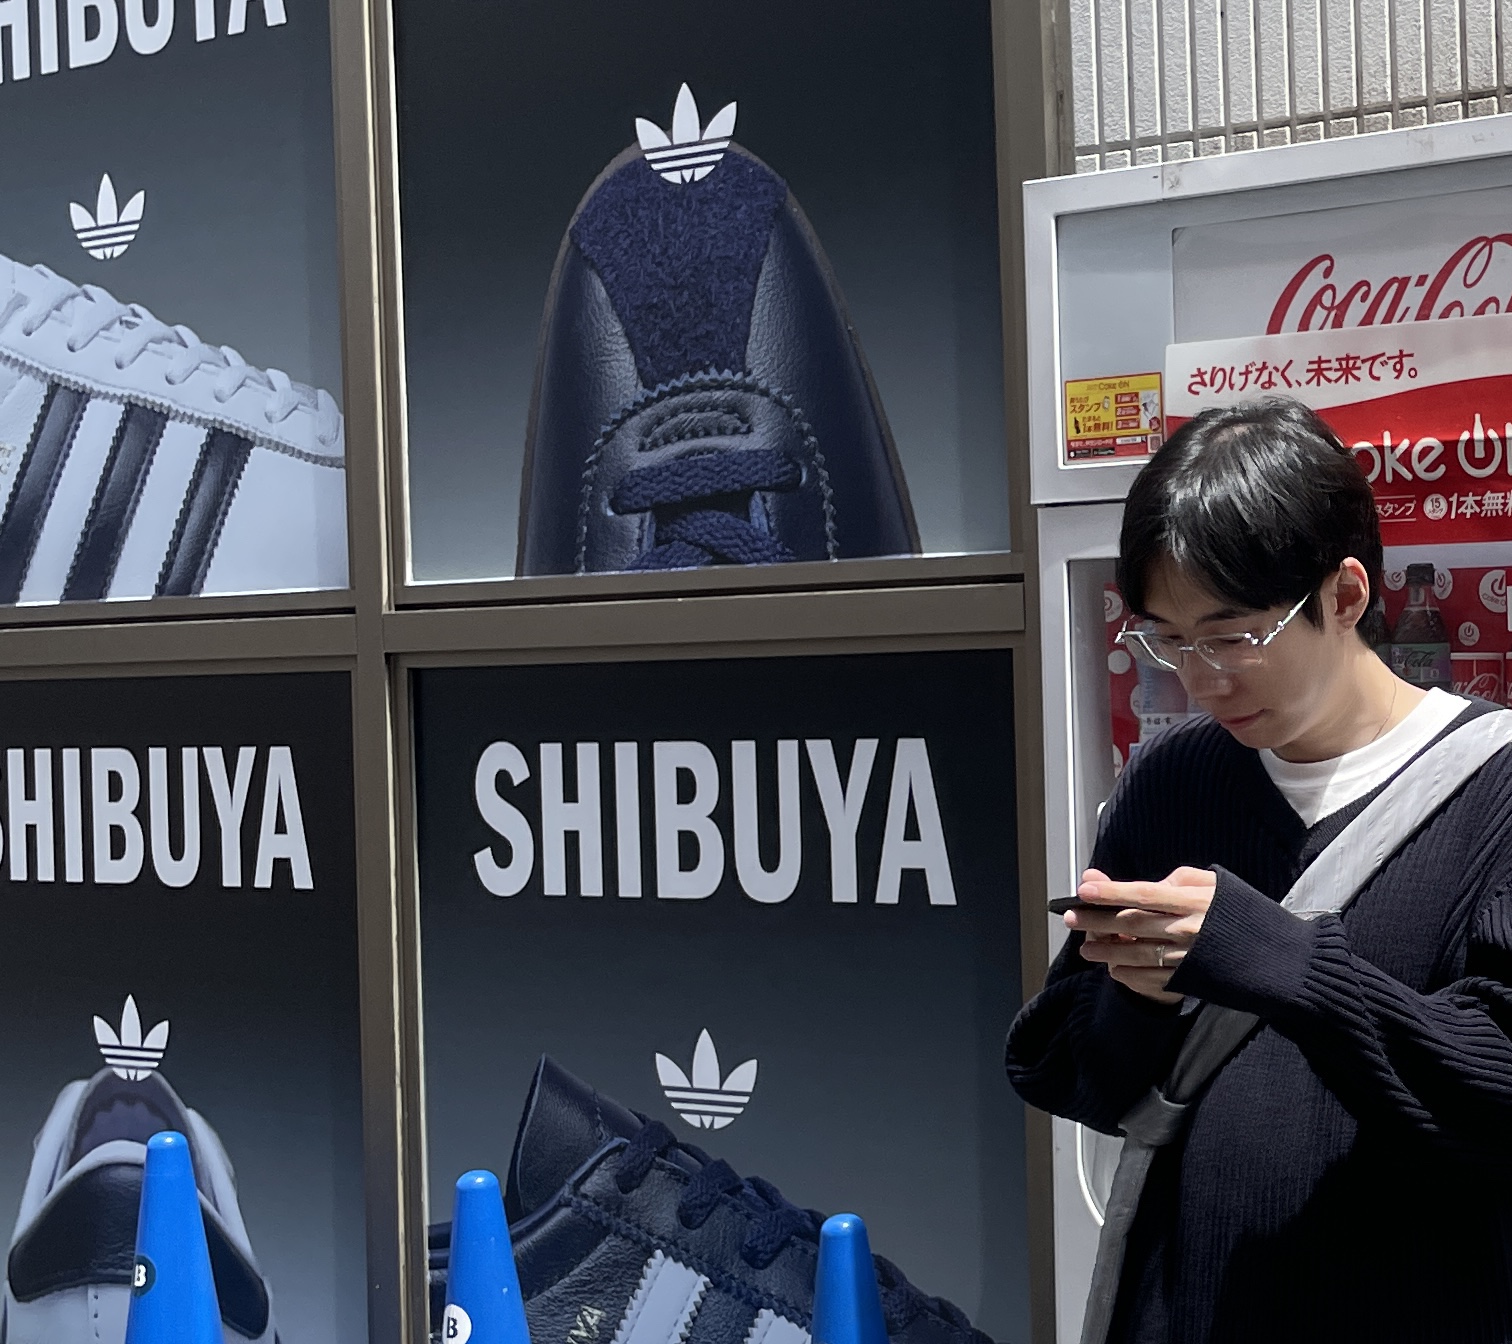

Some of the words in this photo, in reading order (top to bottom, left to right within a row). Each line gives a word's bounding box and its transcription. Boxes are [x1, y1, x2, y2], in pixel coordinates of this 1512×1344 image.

[1187, 349, 1418, 396] さりげなく、未来です。
[1069, 403, 1103, 414] スタンプ
[1349, 430, 1447, 484] oke
[0, 744, 314, 891] HIBUYA
[474, 737, 957, 906] SHIBUYA
[134, 1264, 147, 1287] B
[446, 1316, 458, 1339] B
